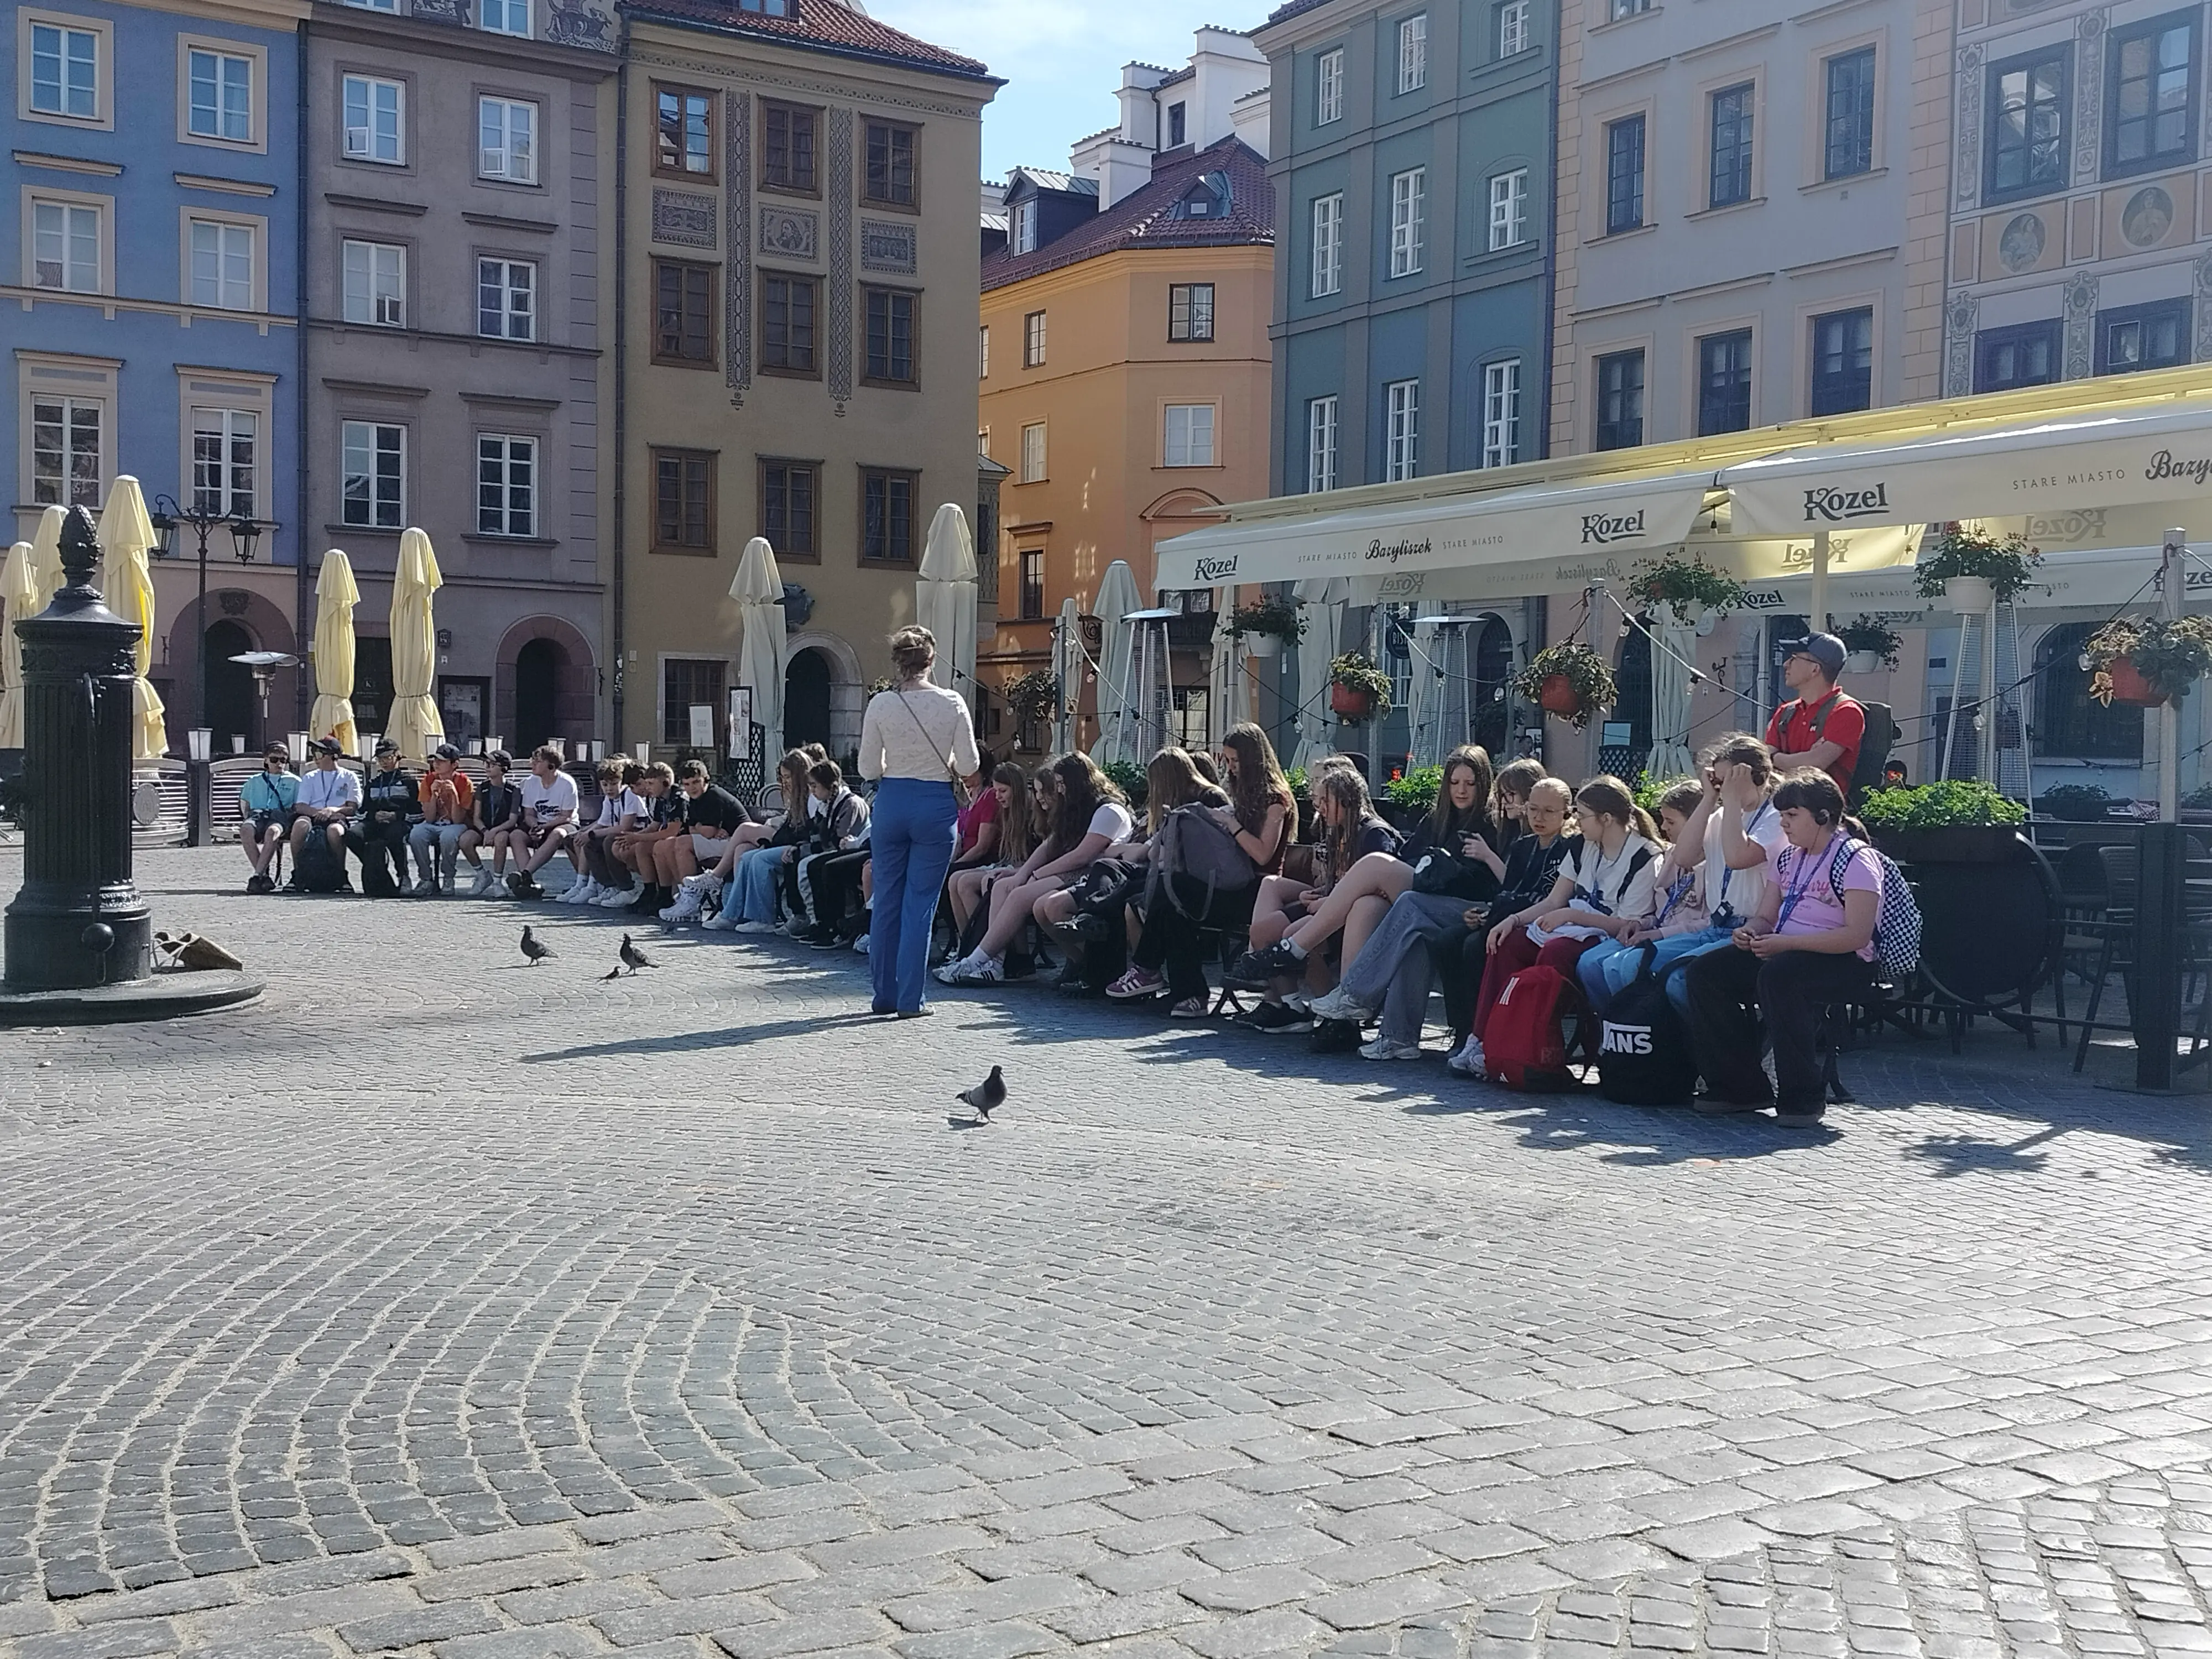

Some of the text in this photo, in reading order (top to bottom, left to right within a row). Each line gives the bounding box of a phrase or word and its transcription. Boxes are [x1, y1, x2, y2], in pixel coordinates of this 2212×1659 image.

[2013, 448, 2212, 490] STARE MIASTO Bazy
[1803, 482, 1890, 521] Kozel
[1580, 509, 1646, 544] Kozel
[1298, 535, 1503, 563] STARE MIASTO Bazyliszek STARE MIASTO
[1193, 555, 1238, 581] Kozel
[1736, 589, 1786, 609] Kozel
